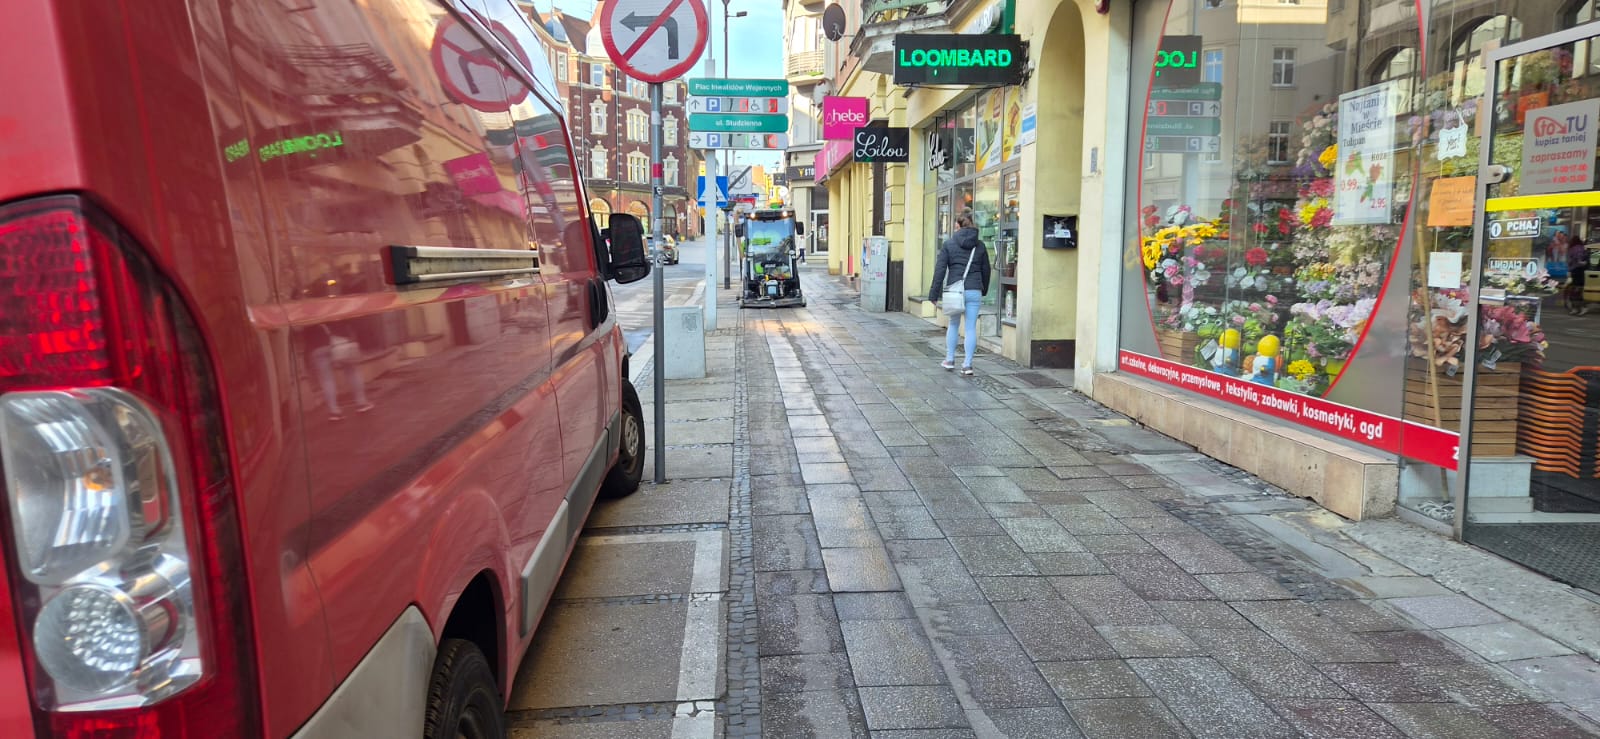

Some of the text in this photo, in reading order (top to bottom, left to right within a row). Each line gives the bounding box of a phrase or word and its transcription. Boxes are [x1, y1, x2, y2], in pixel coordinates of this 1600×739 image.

[900, 49, 1012, 67] LOOMBARD
[832, 109, 864, 122] hebe
[1566, 114, 1587, 133] TU
[855, 131, 907, 158] Lilou
[1535, 132, 1586, 148] kupisz taniej
[1530, 149, 1588, 163] zapraszamy
[1507, 220, 1539, 231] PCHAJ
[1261, 393, 1301, 418] zabawki,
[1303, 402, 1357, 433] kosmetyki,
[1360, 422, 1383, 440] agd
